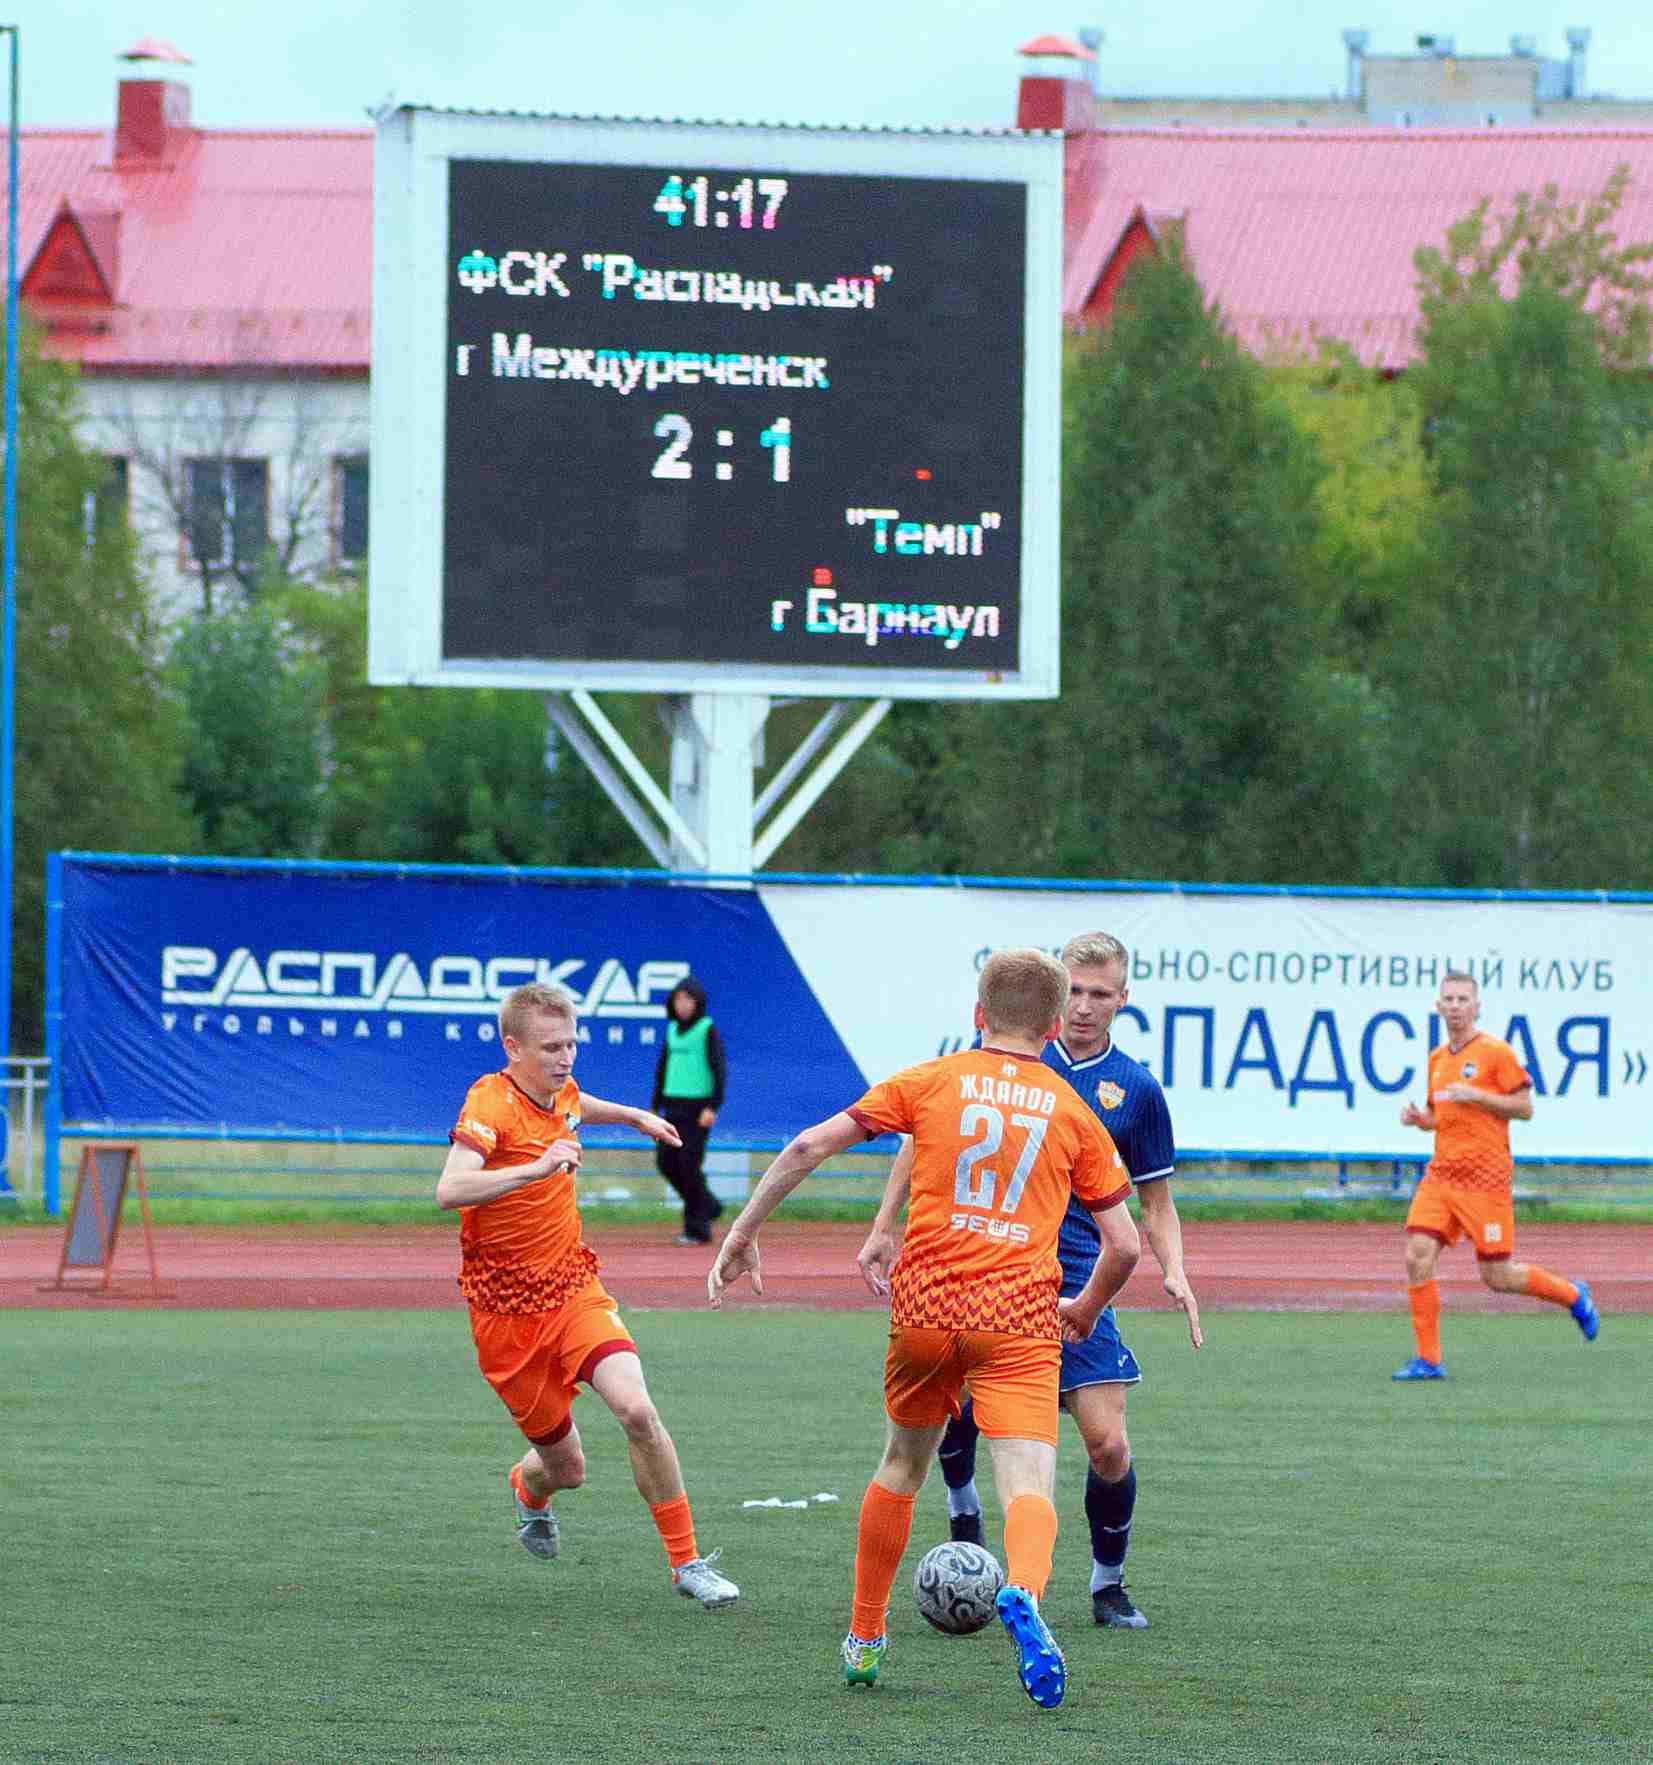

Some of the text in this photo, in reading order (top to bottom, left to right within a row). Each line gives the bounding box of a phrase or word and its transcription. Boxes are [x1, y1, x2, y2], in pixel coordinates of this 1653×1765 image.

[654, 175, 788, 229] 41:17
[457, 249, 570, 298] ФСК
[456, 332, 831, 396] г Междуреченск
[651, 413, 694, 480] 2
[759, 416, 791, 482] 1
[845, 507, 1002, 556] "Темп"
[770, 587, 1001, 650] г Барнаул
[1518, 956, 1615, 992] КЛУБ
[160, 1011, 657, 1045] УГОЛЬНАЯ КОАНИ
[959, 1073, 1057, 1116] ЖДАНОВ
[953, 1102, 1049, 1215] 27
